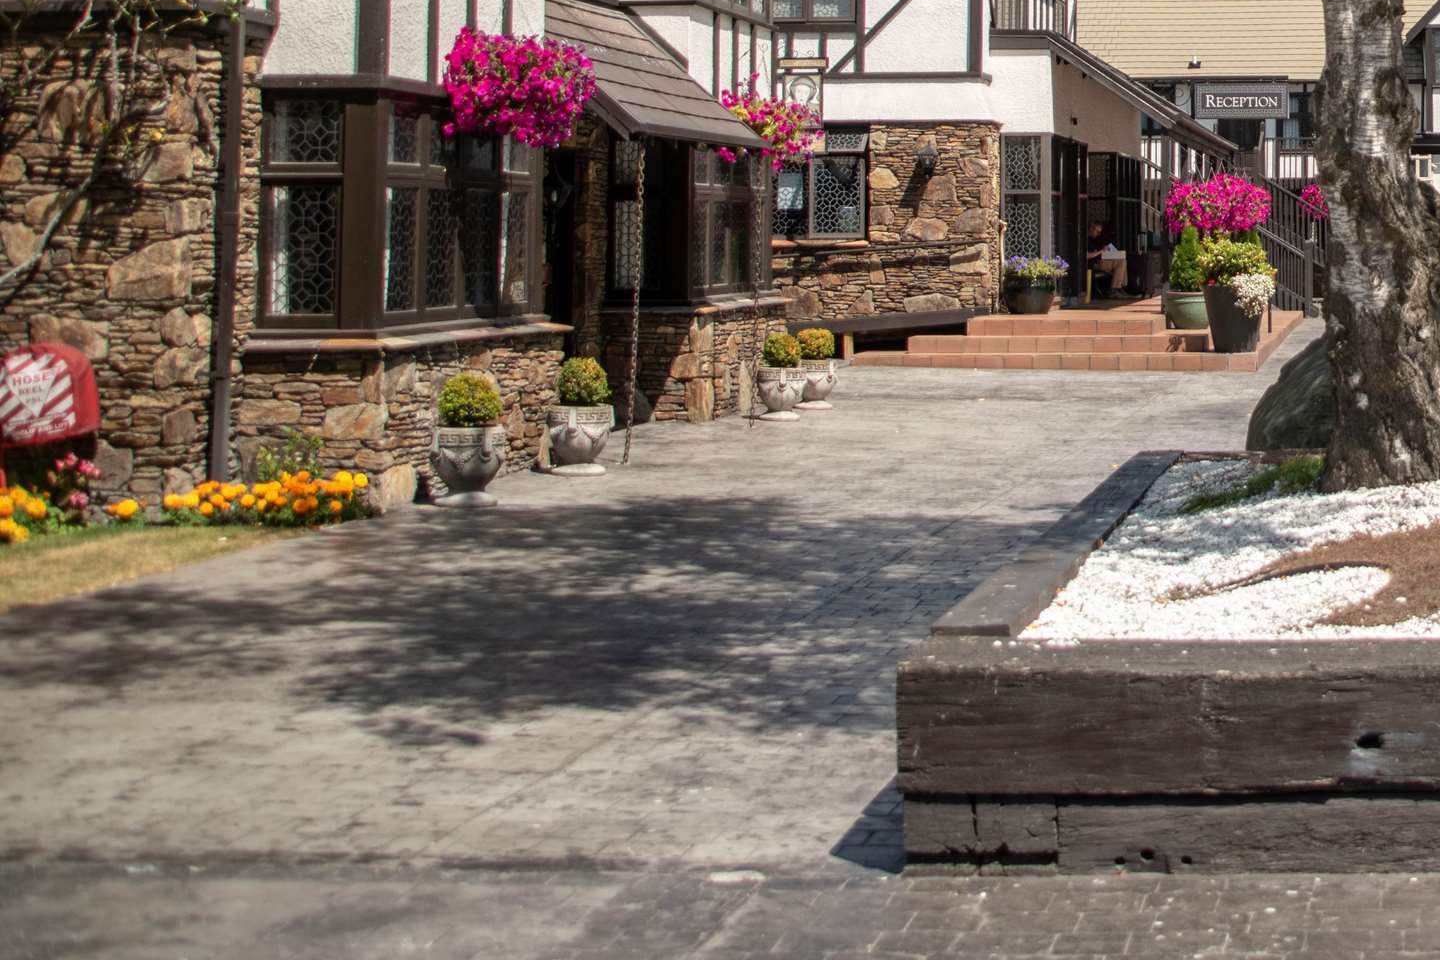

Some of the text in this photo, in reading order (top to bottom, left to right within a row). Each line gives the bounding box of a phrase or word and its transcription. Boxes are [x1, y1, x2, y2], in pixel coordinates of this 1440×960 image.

[1205, 94, 1278, 108] RECEPTION
[13, 372, 49, 385] HOSE
[19, 386, 43, 396] REEL
